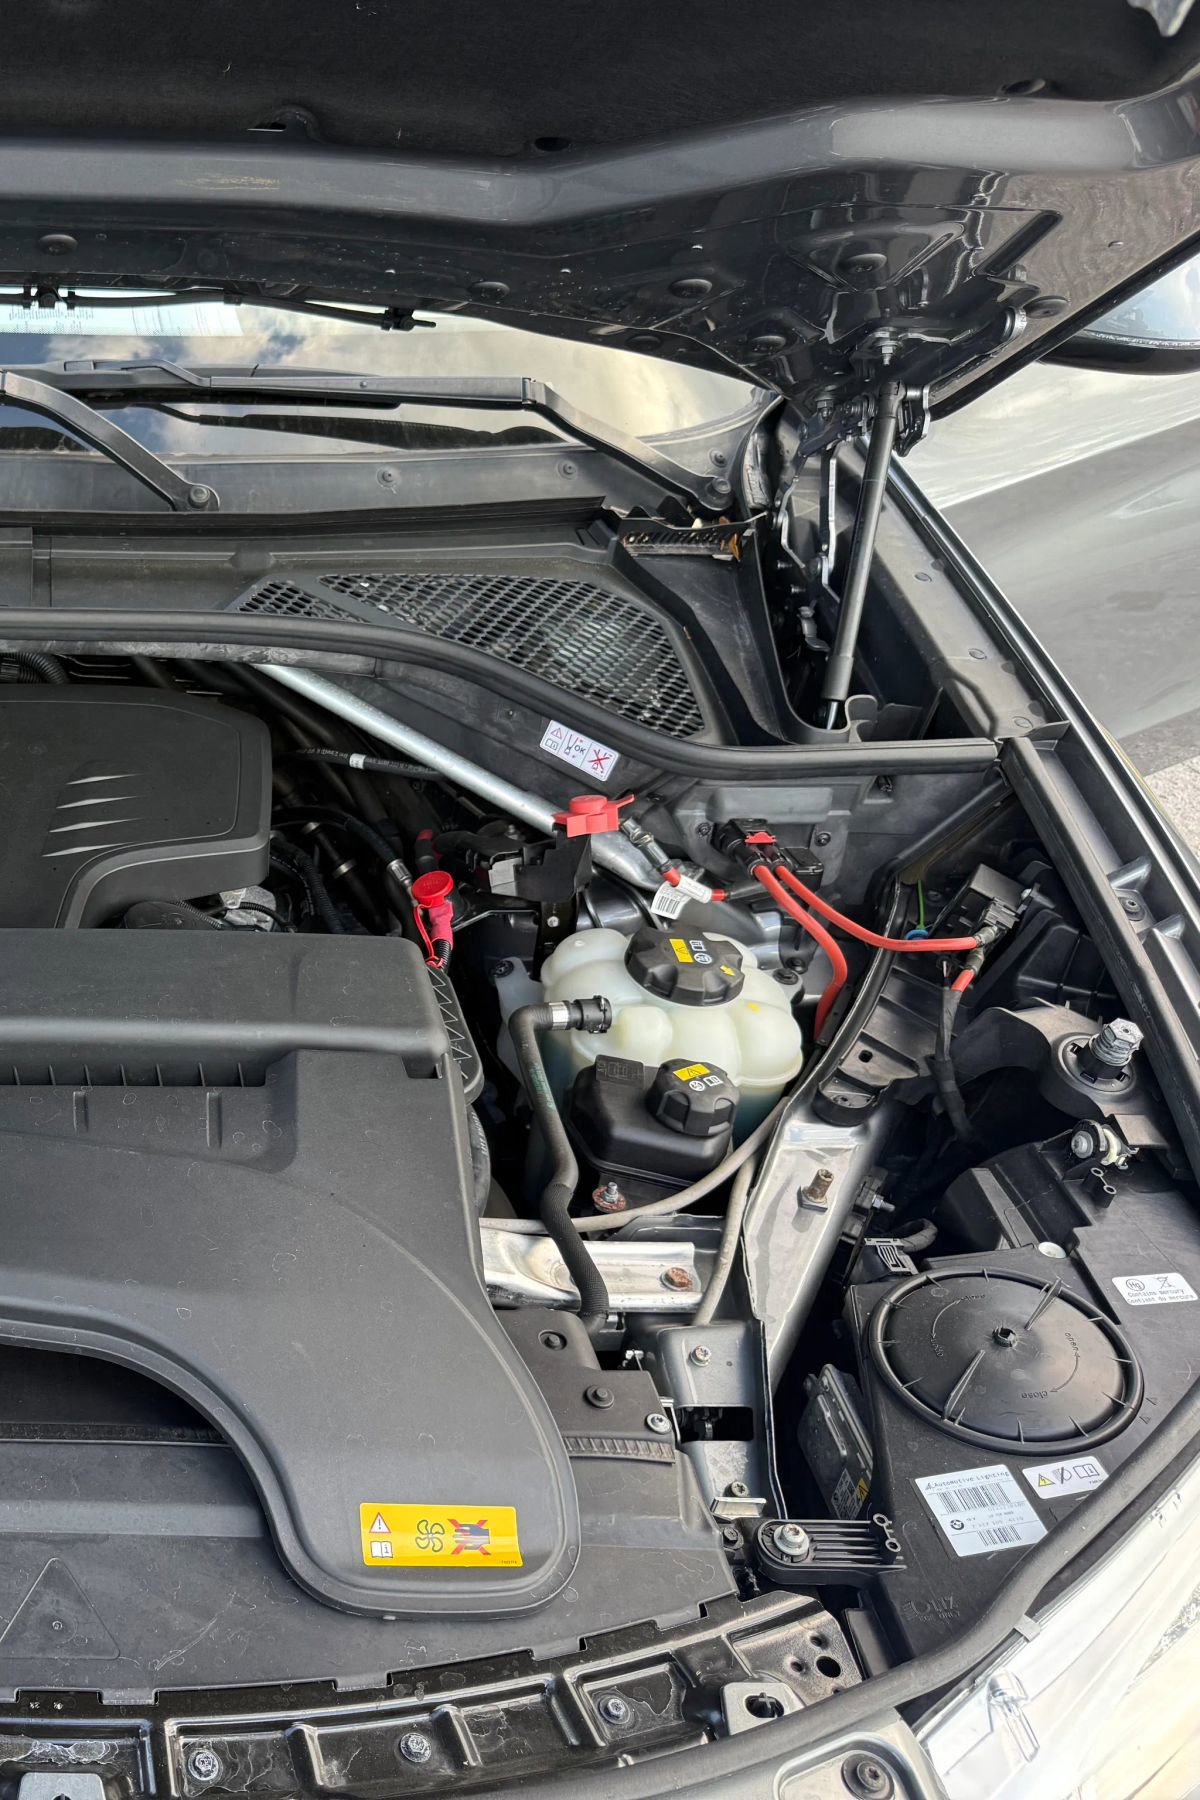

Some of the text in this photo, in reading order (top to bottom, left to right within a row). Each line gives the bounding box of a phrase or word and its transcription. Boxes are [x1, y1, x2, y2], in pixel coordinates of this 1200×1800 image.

[574, 744, 586, 755] OK
[1021, 1390, 1048, 1399] close
[932, 1471, 1010, 1487] Automotive Lighting
